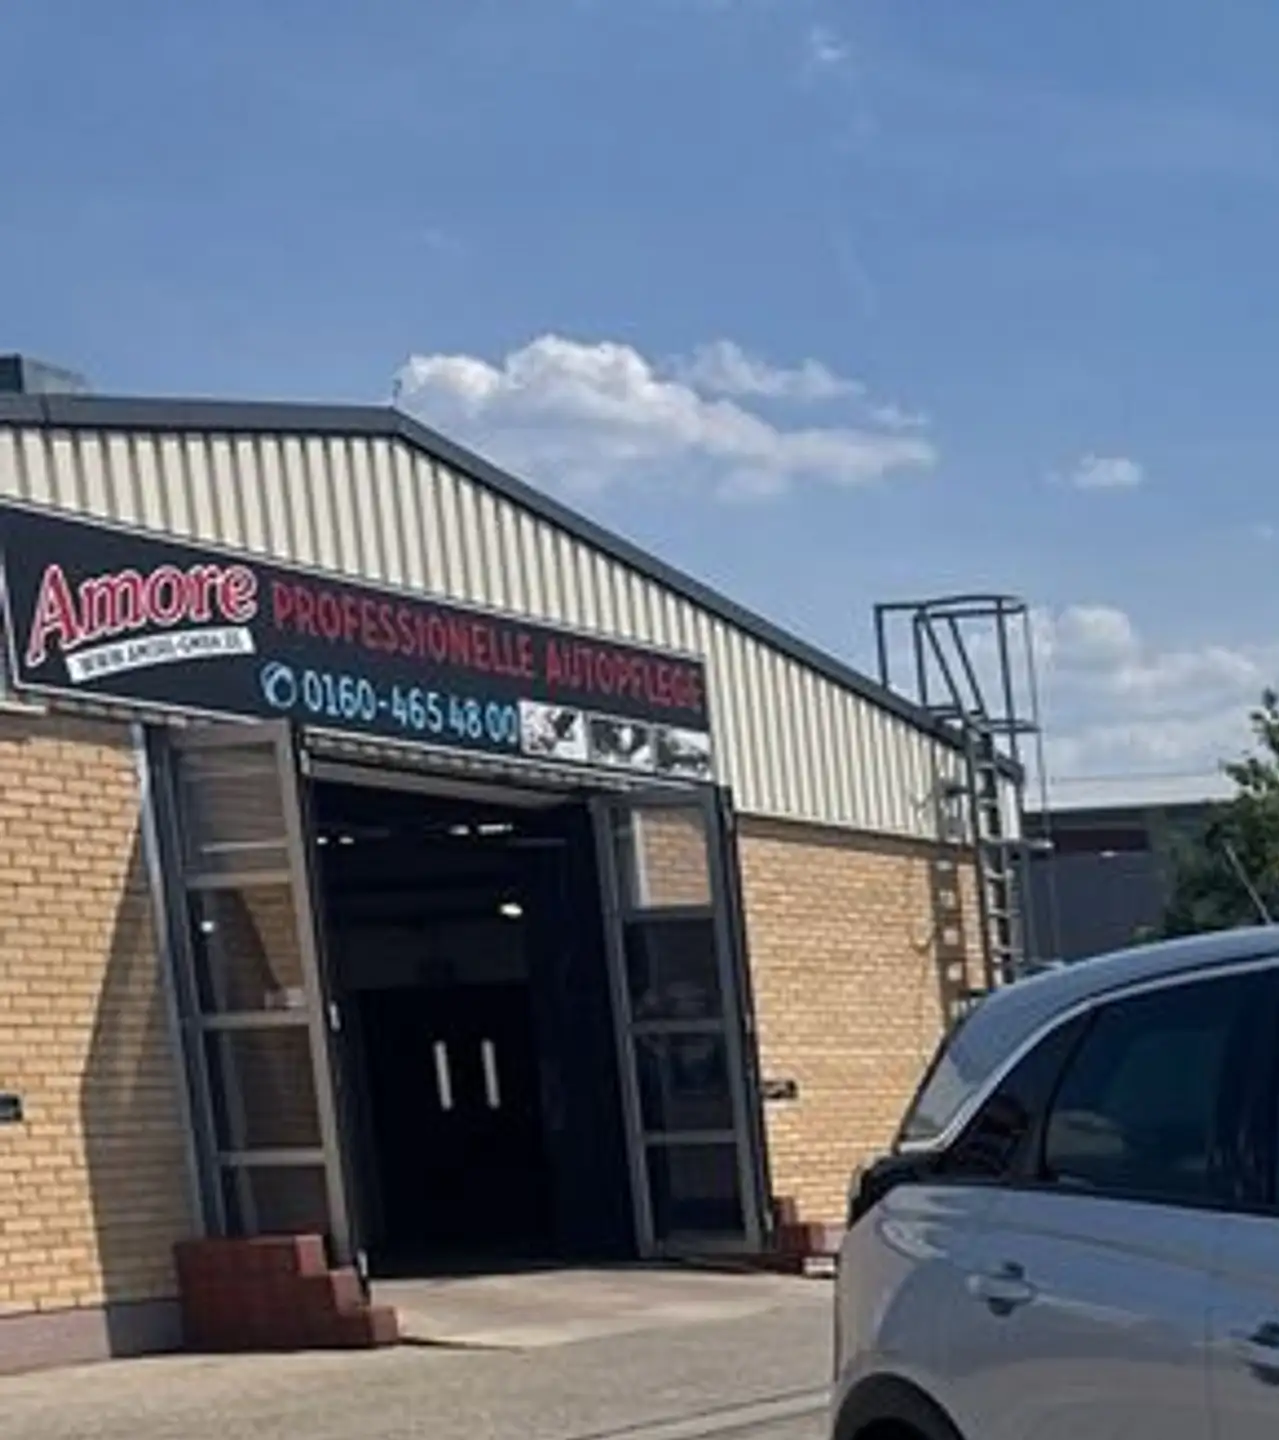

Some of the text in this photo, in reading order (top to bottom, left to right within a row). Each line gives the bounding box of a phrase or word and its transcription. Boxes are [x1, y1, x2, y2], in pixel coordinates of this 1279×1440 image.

[26, 564, 257, 668] Amore
[272, 580, 704, 708] PROFESSIONELLE AUTOPFLEGE
